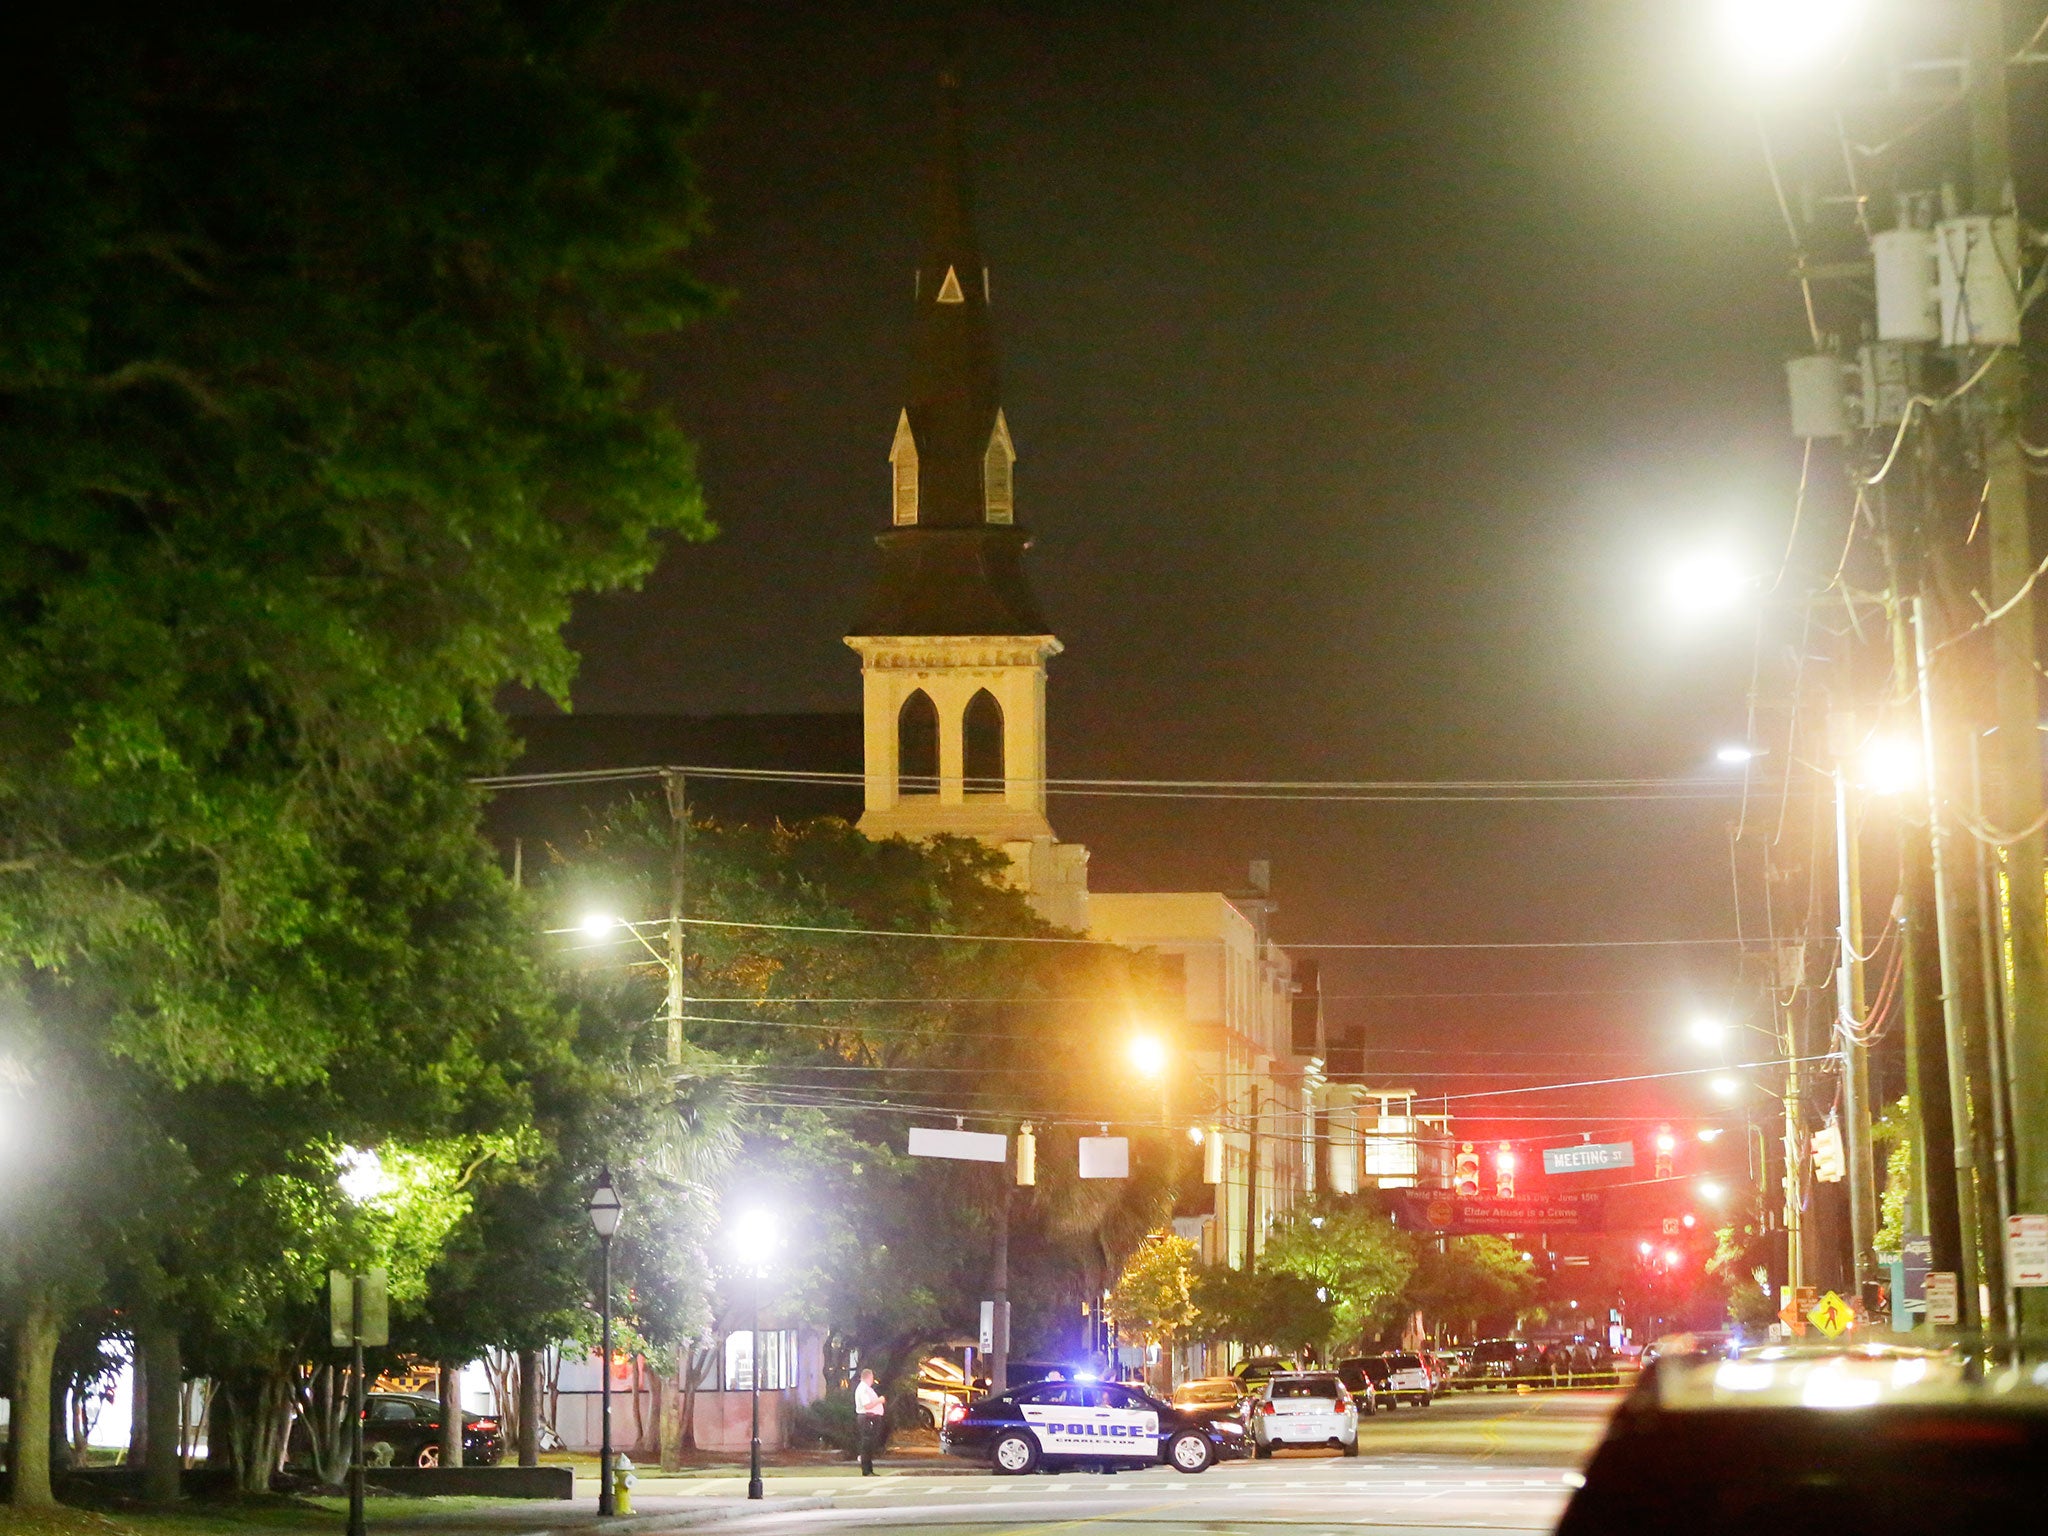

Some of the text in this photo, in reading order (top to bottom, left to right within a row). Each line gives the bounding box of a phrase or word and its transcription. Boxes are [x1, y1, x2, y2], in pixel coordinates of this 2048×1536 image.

[1554, 1150, 1622, 1167] MEETING ST
[1405, 1190, 1430, 1200] World
[1558, 1193, 1578, 1201] June
[1581, 1192, 1599, 1201] 15th
[1464, 1207, 1490, 1216] Elder
[1492, 1208, 1524, 1217] Abuse
[1527, 1207, 1536, 1217] is
[1547, 1208, 1577, 1217] Crime
[1047, 1423, 1144, 1438] POLICE
